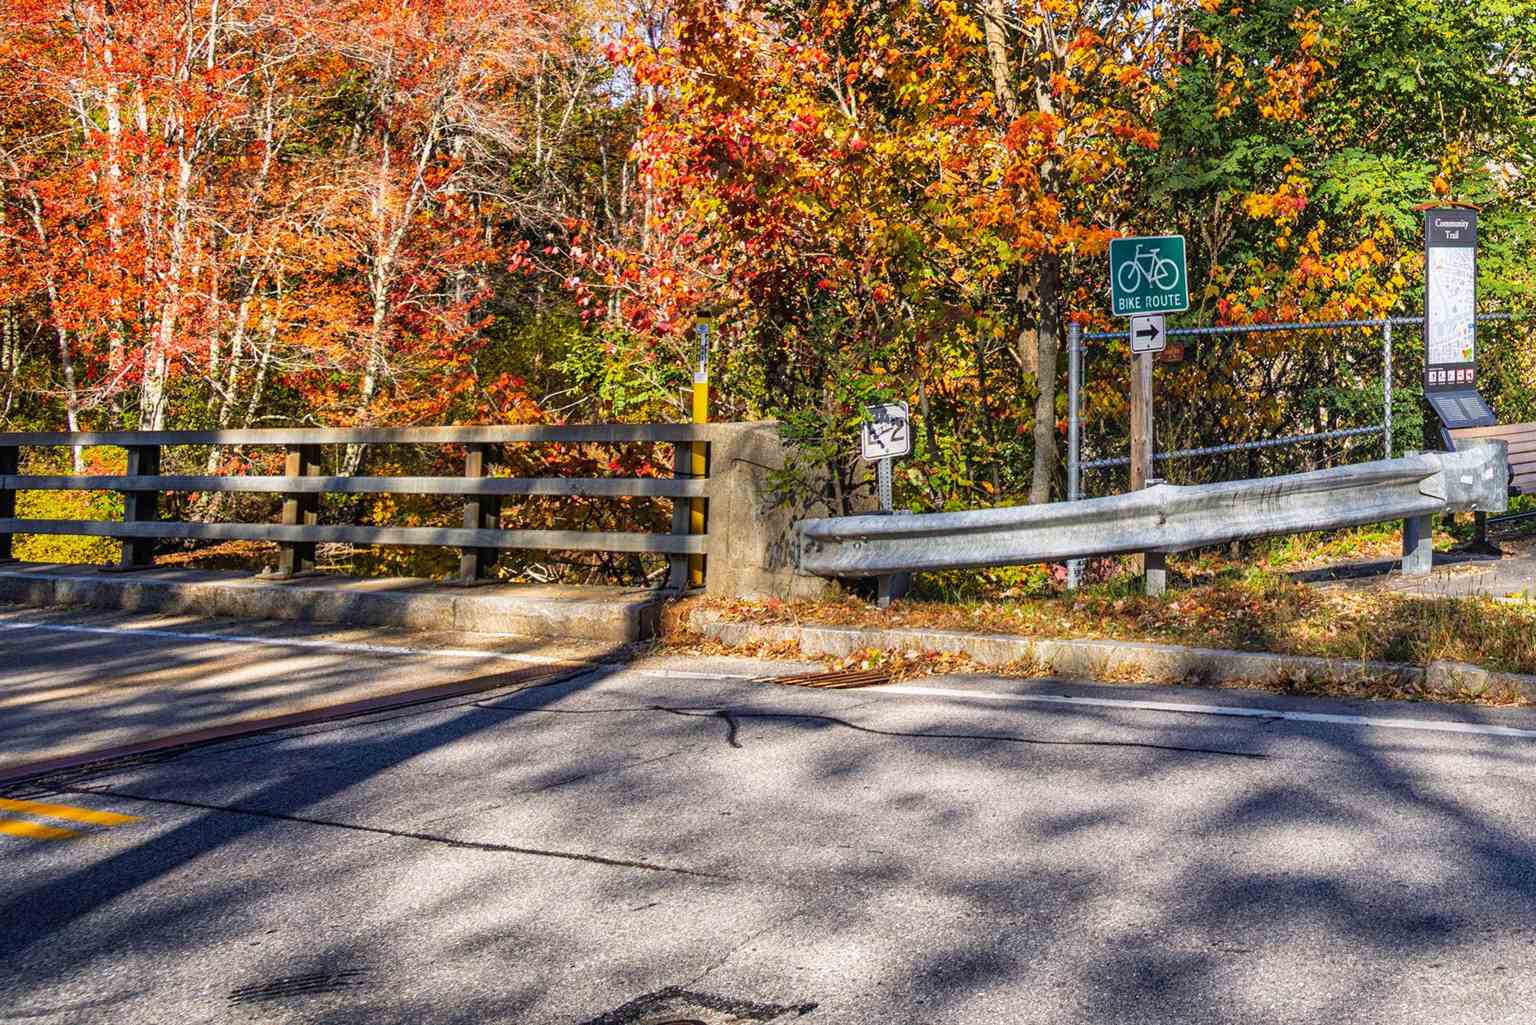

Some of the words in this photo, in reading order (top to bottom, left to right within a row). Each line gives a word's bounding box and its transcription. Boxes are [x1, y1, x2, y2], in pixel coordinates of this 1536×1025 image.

[1434, 218, 1469, 230] Community
[1445, 230, 1460, 239] Trail
[1118, 296, 1141, 310] BIKE
[1145, 294, 1181, 308] ROUTE
